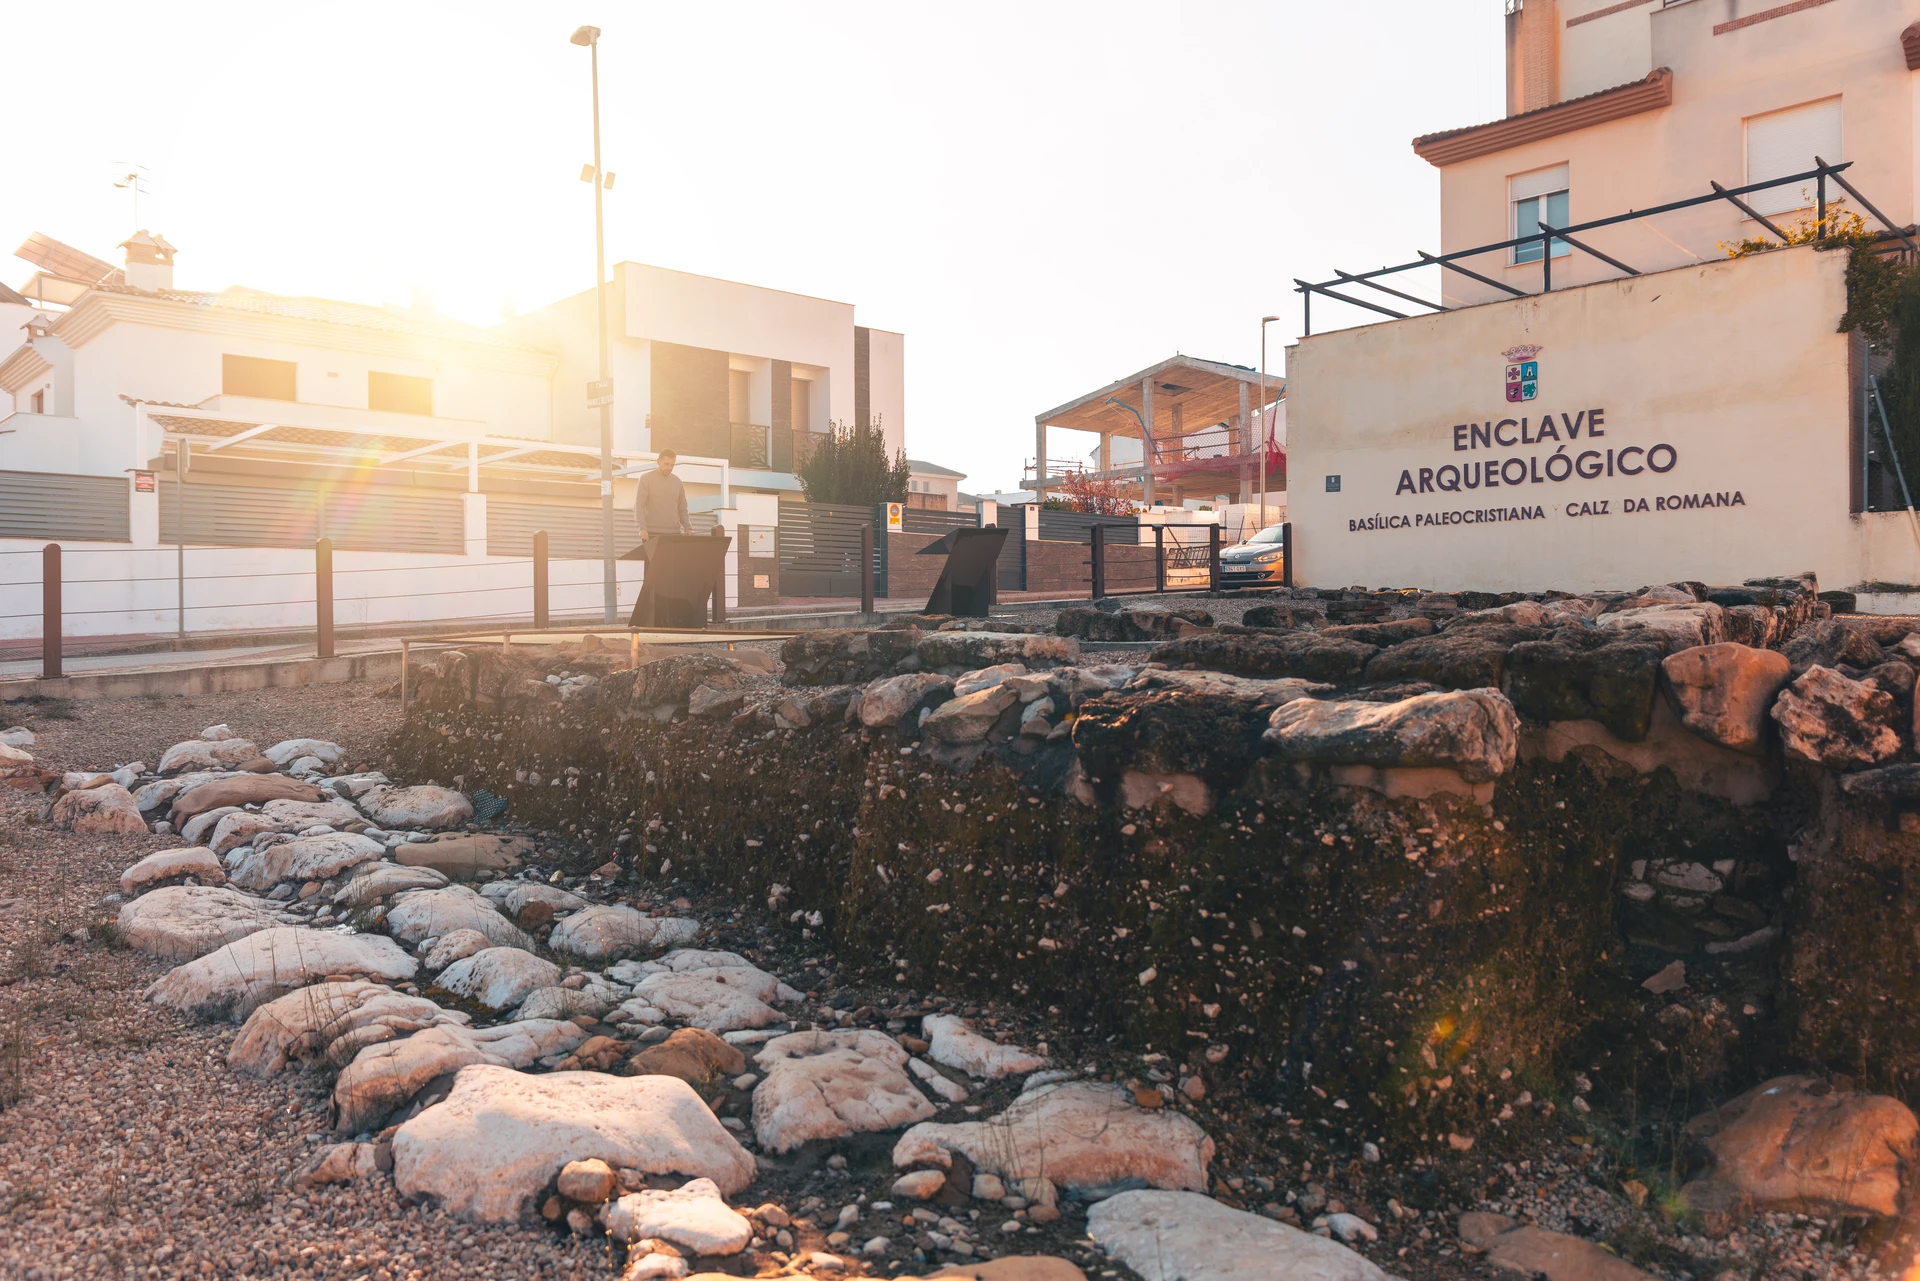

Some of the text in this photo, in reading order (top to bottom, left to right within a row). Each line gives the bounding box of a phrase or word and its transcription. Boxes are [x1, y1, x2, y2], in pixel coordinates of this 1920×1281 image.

[1453, 408, 1605, 451] ENCLAVE
[1395, 443, 1678, 495] ARQUEOLÓGICO
[1349, 513, 1411, 532] BASÍLICA
[1415, 505, 1546, 527] PALEOCRISTIANA
[1655, 491, 1746, 511] ROMANA
